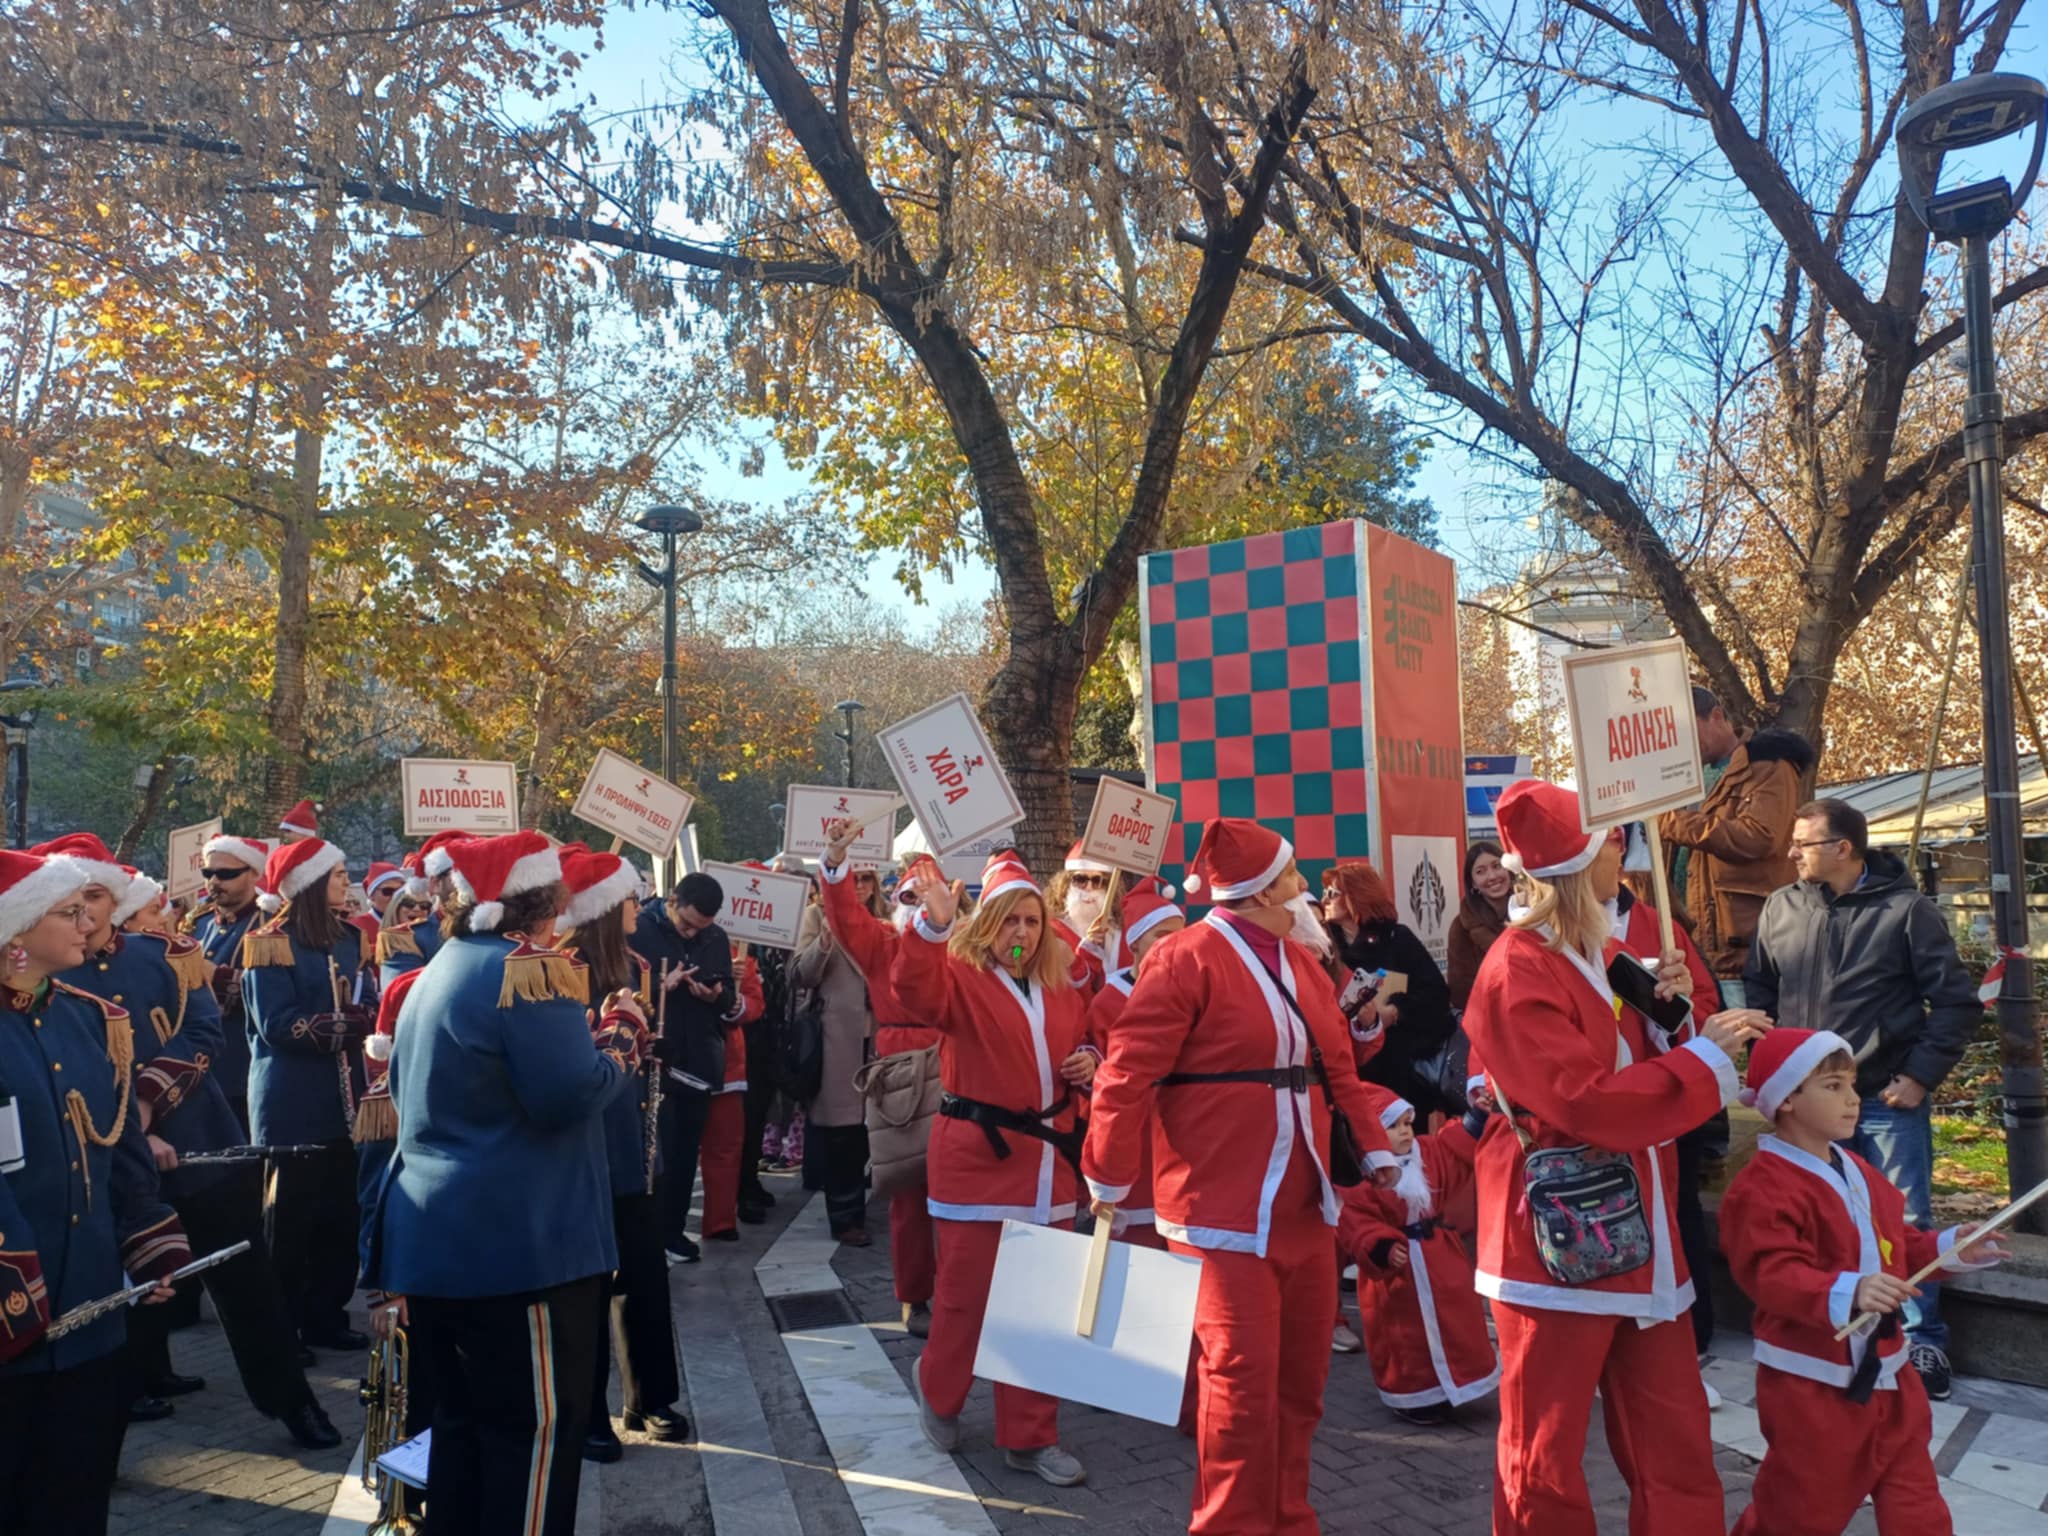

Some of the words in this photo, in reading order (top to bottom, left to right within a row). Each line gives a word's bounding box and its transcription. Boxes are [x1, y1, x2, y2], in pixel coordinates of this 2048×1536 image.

[1607, 704, 1678, 763] ΑΘΛΗΣΗ
[925, 746, 970, 805] ΧΑΡΑ
[418, 788, 506, 808] ΑΙΣΙΟΔΟΞΙΑ
[1108, 813, 1154, 846] ΘΑΡΡΟΣ
[731, 896, 773, 922] ΥΓΕΙΑ
